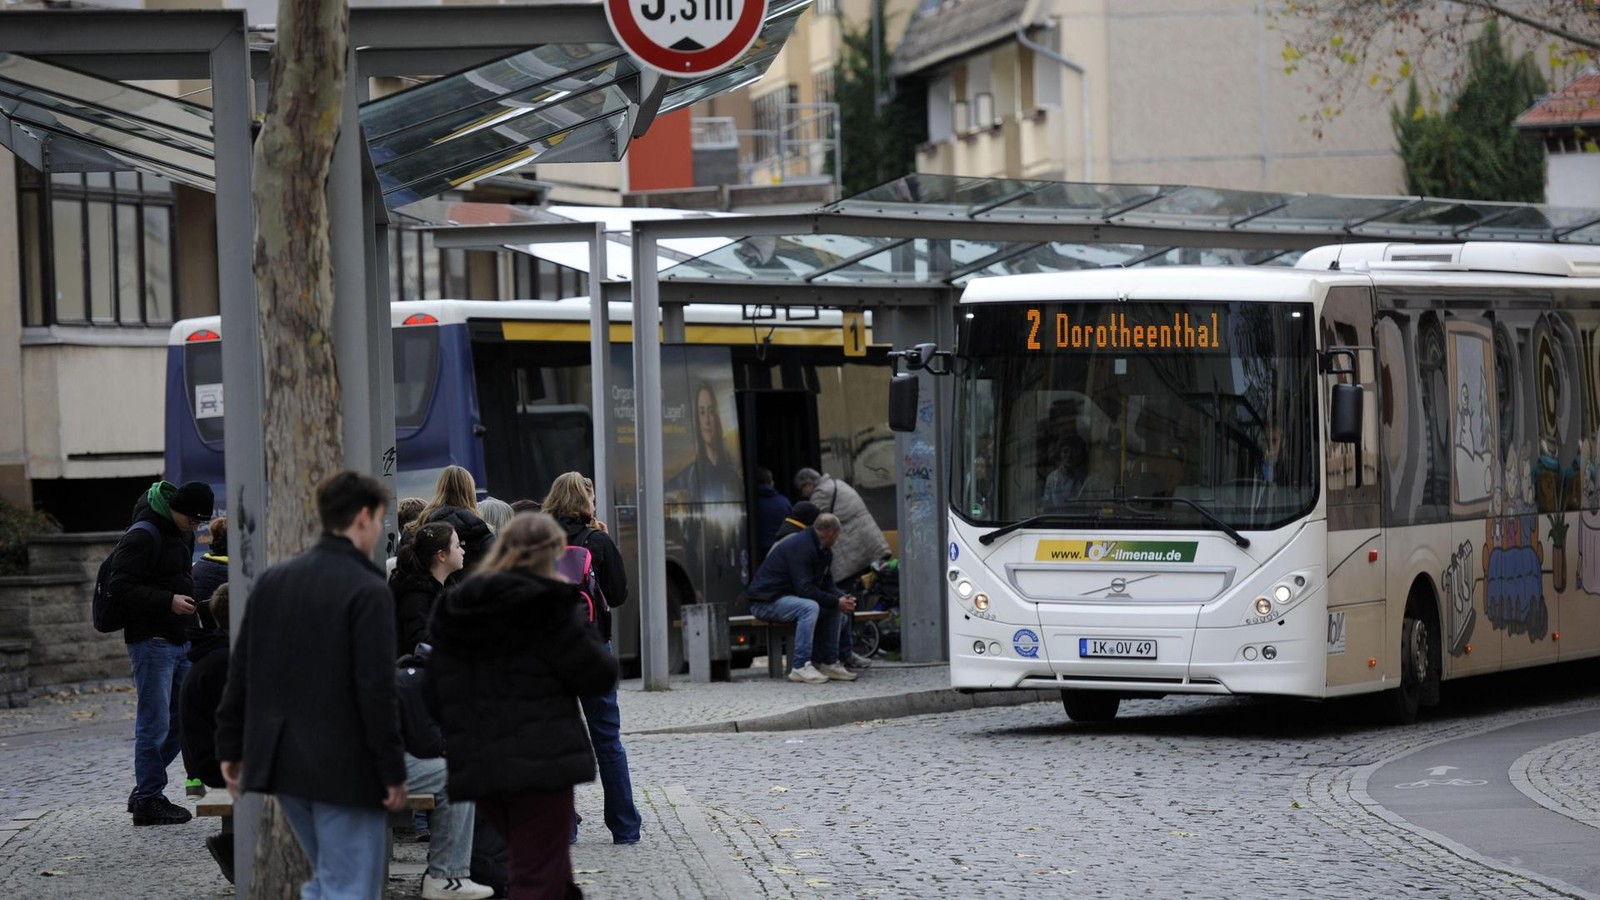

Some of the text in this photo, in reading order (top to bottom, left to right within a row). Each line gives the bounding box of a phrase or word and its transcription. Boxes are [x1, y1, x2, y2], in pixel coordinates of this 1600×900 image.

[849, 317, 859, 352] 1
[1027, 309, 1219, 350] 2 Dorotheenthal
[1092, 641, 1152, 655] IK OV 49
